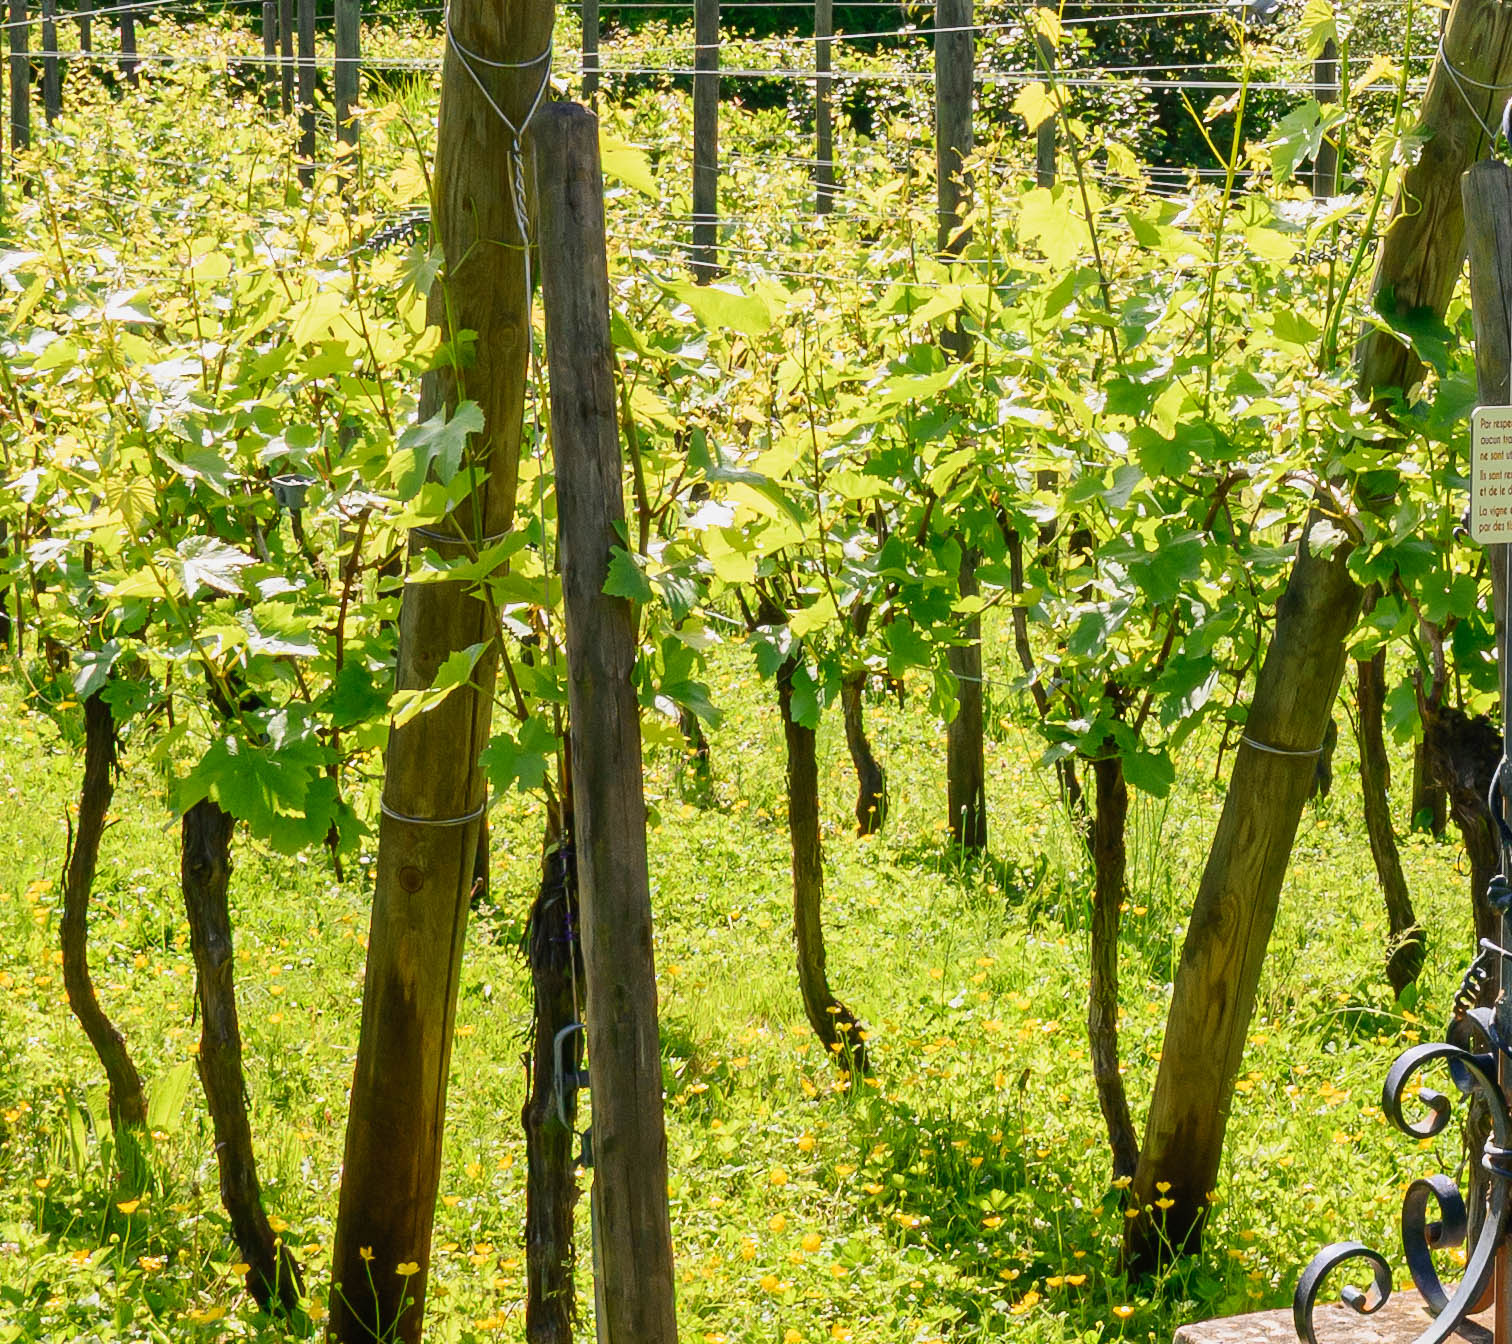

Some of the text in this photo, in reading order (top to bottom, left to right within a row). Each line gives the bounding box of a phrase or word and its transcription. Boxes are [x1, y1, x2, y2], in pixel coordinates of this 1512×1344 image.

[1480, 417, 1491, 429] Par
[1480, 436, 1501, 445] aucun
[1480, 452, 1488, 461] ne
[1490, 450, 1504, 461] sont
[1488, 469, 1502, 481] sont
[1480, 487, 1487, 497] et
[1488, 485, 1498, 496] de
[1500, 484, 1506, 496] le
[1479, 505, 1488, 517] La
[1489, 506, 1508, 518] vigne
[1479, 523, 1491, 534] par
[1492, 520, 1505, 532] des
